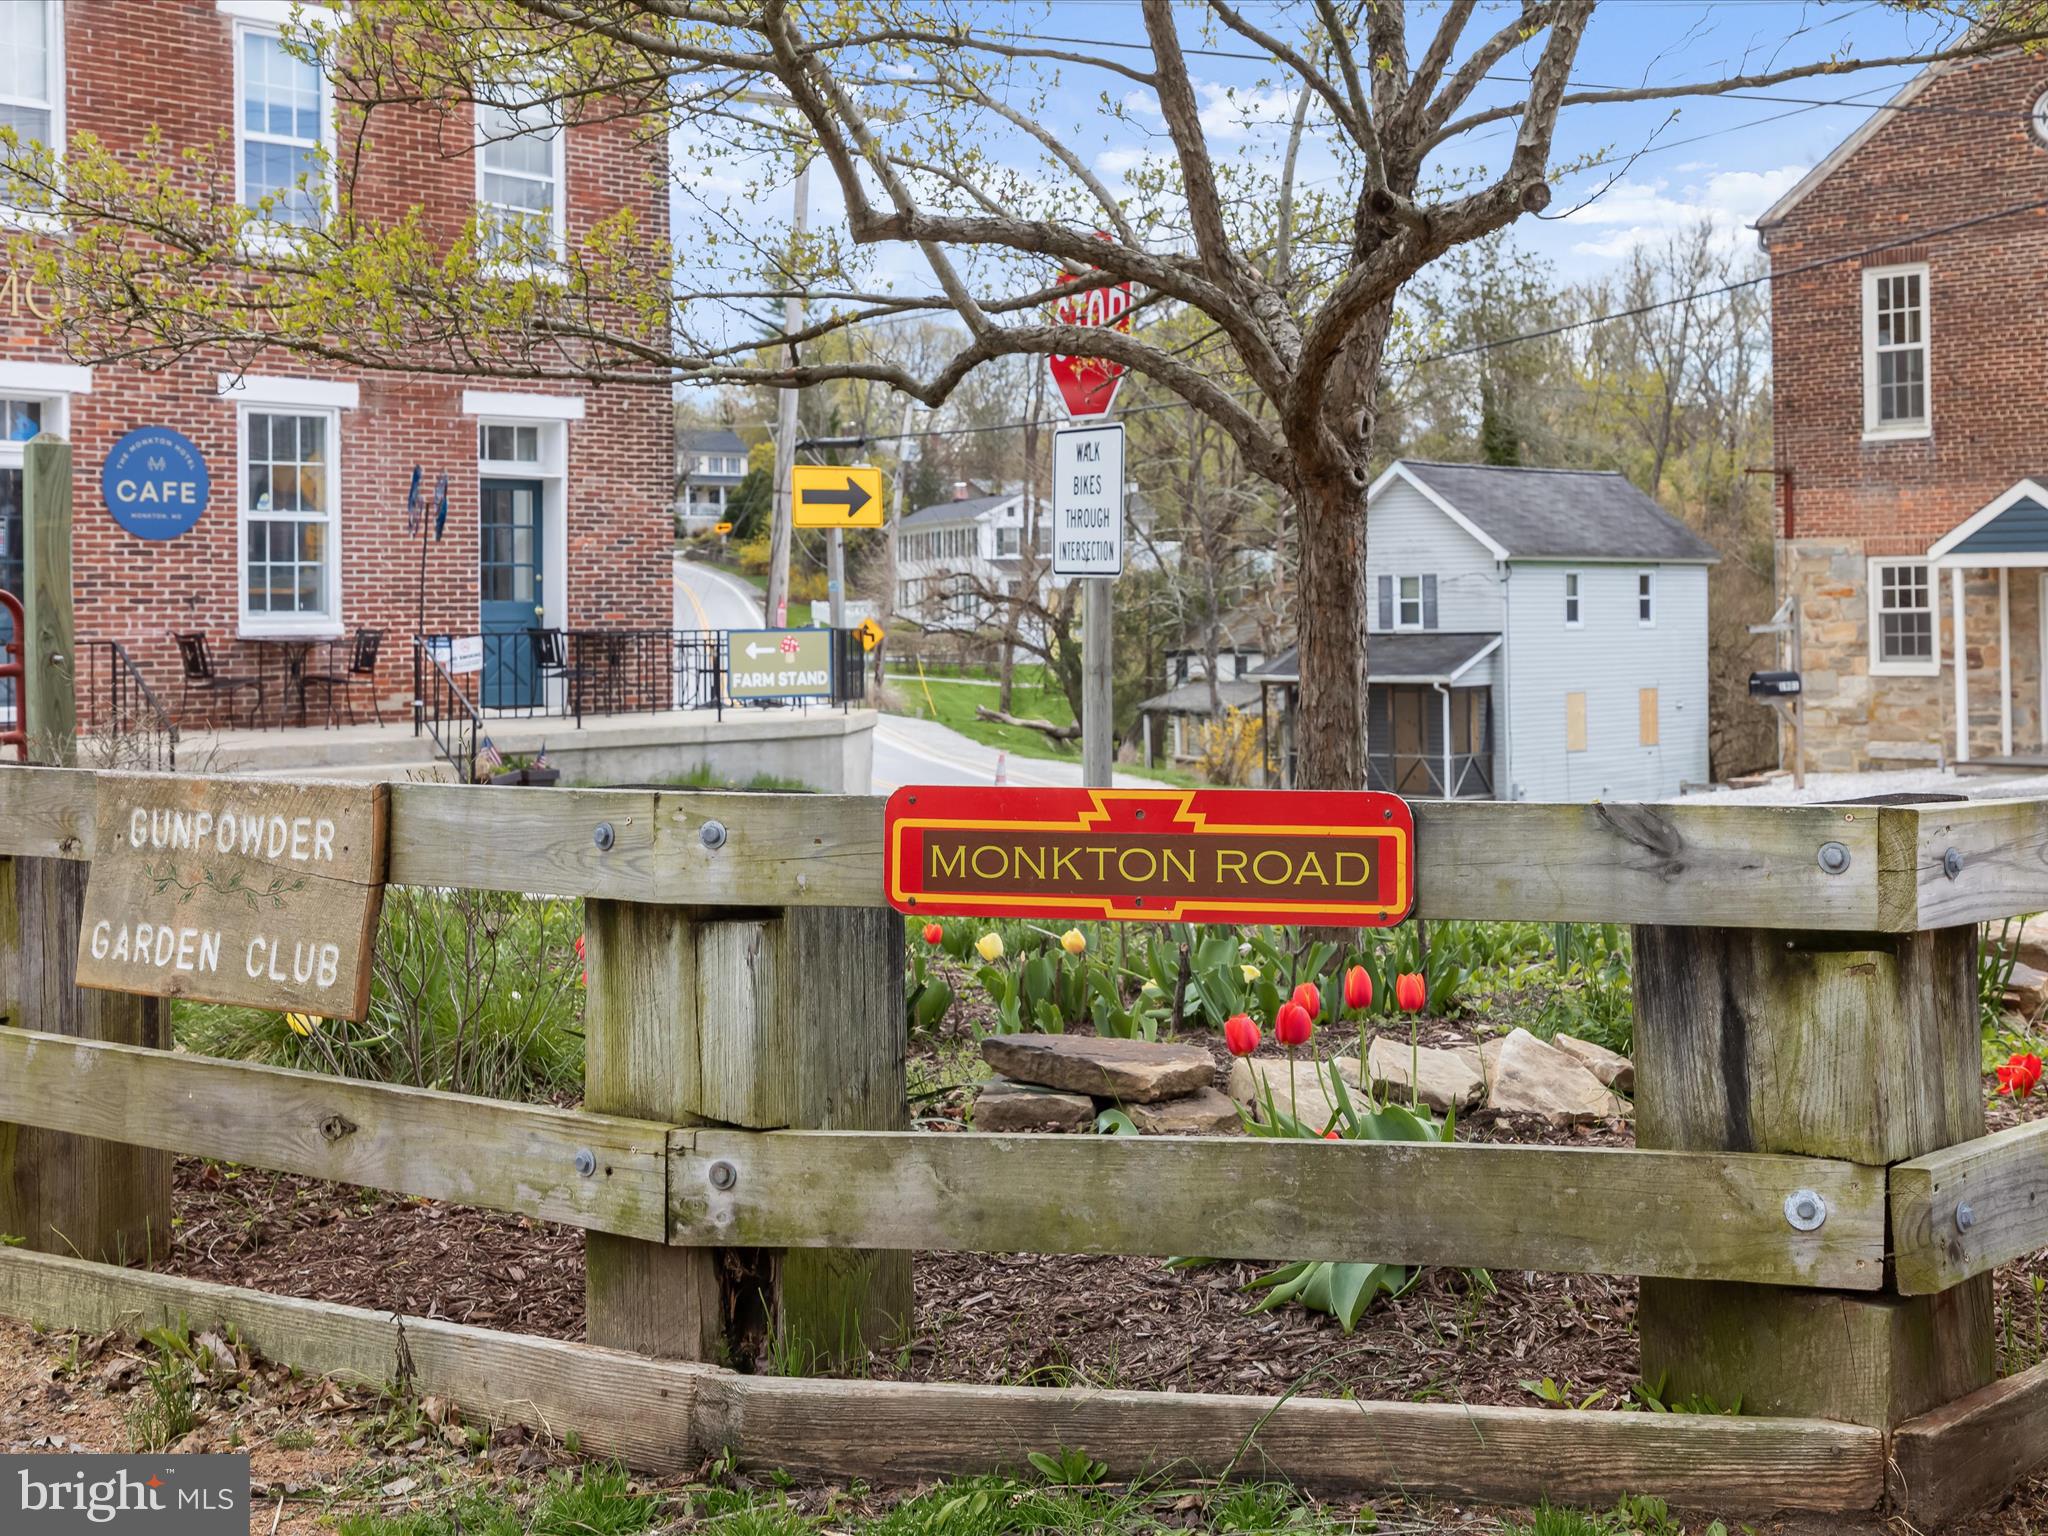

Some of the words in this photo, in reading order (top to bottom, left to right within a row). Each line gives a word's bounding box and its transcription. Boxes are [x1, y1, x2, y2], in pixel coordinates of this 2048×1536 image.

[116, 452, 129, 470] THE
[128, 436, 173, 453] MONKTON
[174, 444, 195, 471] HOTEL
[1076, 441, 1101, 462] WALK
[116, 479, 196, 504] CAFE
[1073, 474, 1102, 496] BIKES
[1065, 507, 1110, 528] THROUGH
[1059, 540, 1115, 562] INTERSECTION
[732, 672, 775, 689] FARM
[778, 670, 828, 687] STAND
[129, 805, 335, 863] GUNPOWDER
[930, 843, 1197, 884] MONKTON
[1215, 849, 1371, 887] ROAD
[90, 919, 221, 972] GARDEN
[245, 934, 340, 989] CLUB
